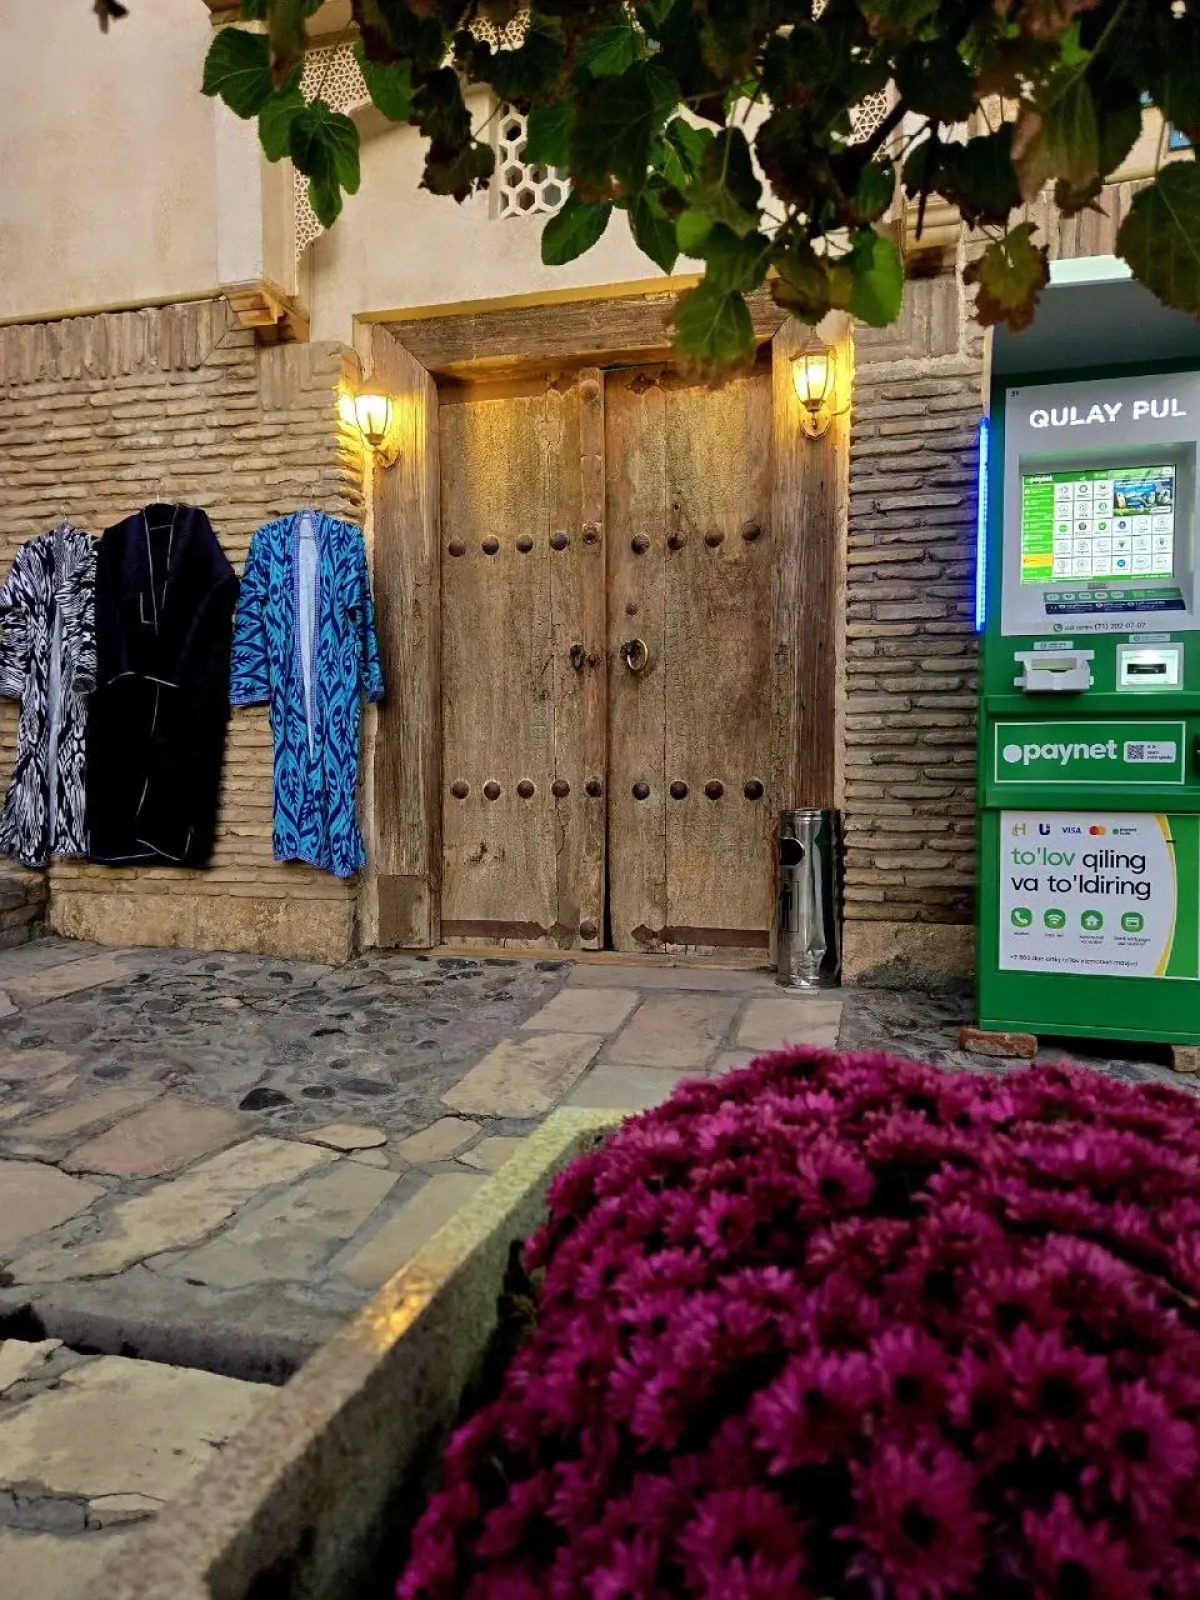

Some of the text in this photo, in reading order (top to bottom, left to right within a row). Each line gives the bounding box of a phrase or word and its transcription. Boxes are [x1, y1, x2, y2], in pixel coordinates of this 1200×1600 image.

[1029, 398, 1187, 429] QULAY PUL
[1023, 740, 1118, 766] paynet
[1061, 826, 1082, 835] VISA
[1011, 847, 1147, 874] to'lov qiling
[1011, 874, 1152, 901] va to'ldiring
